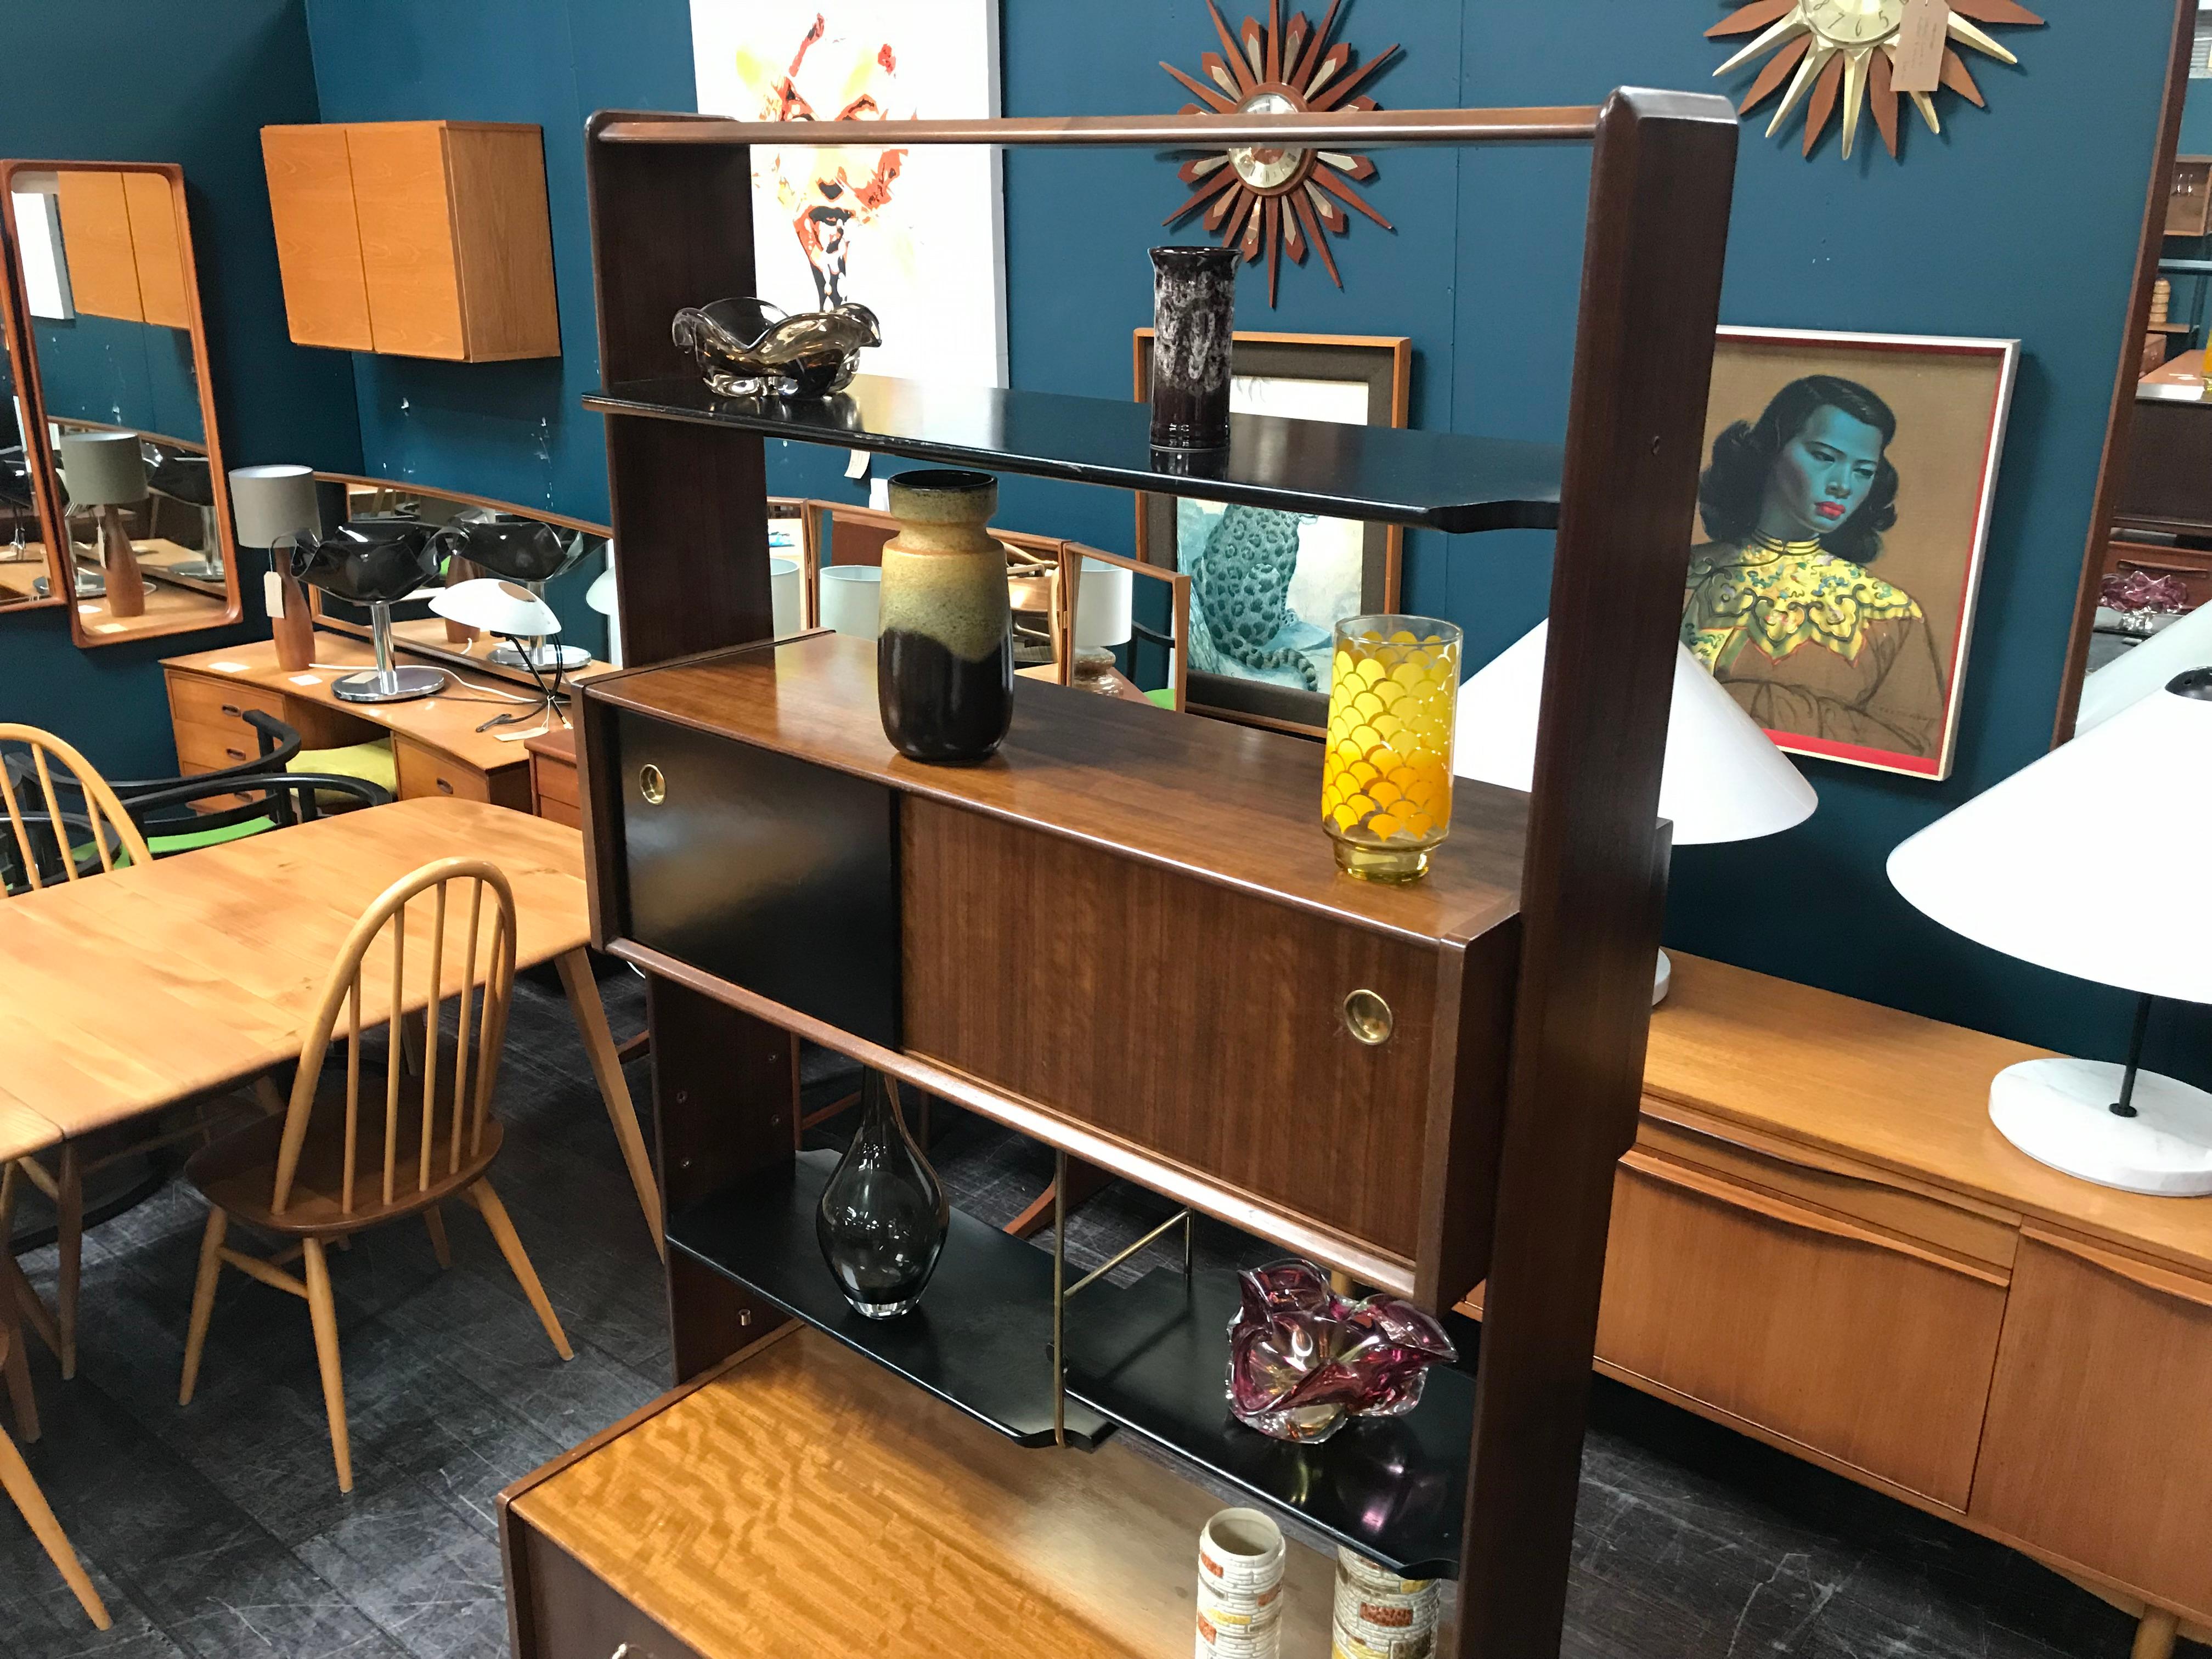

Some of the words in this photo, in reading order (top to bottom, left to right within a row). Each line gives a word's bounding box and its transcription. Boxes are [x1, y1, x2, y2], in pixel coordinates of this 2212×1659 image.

[1828, 11, 1845, 29] 7
[1855, 15, 1862, 37] 6
[1878, 10, 1889, 28] 5
